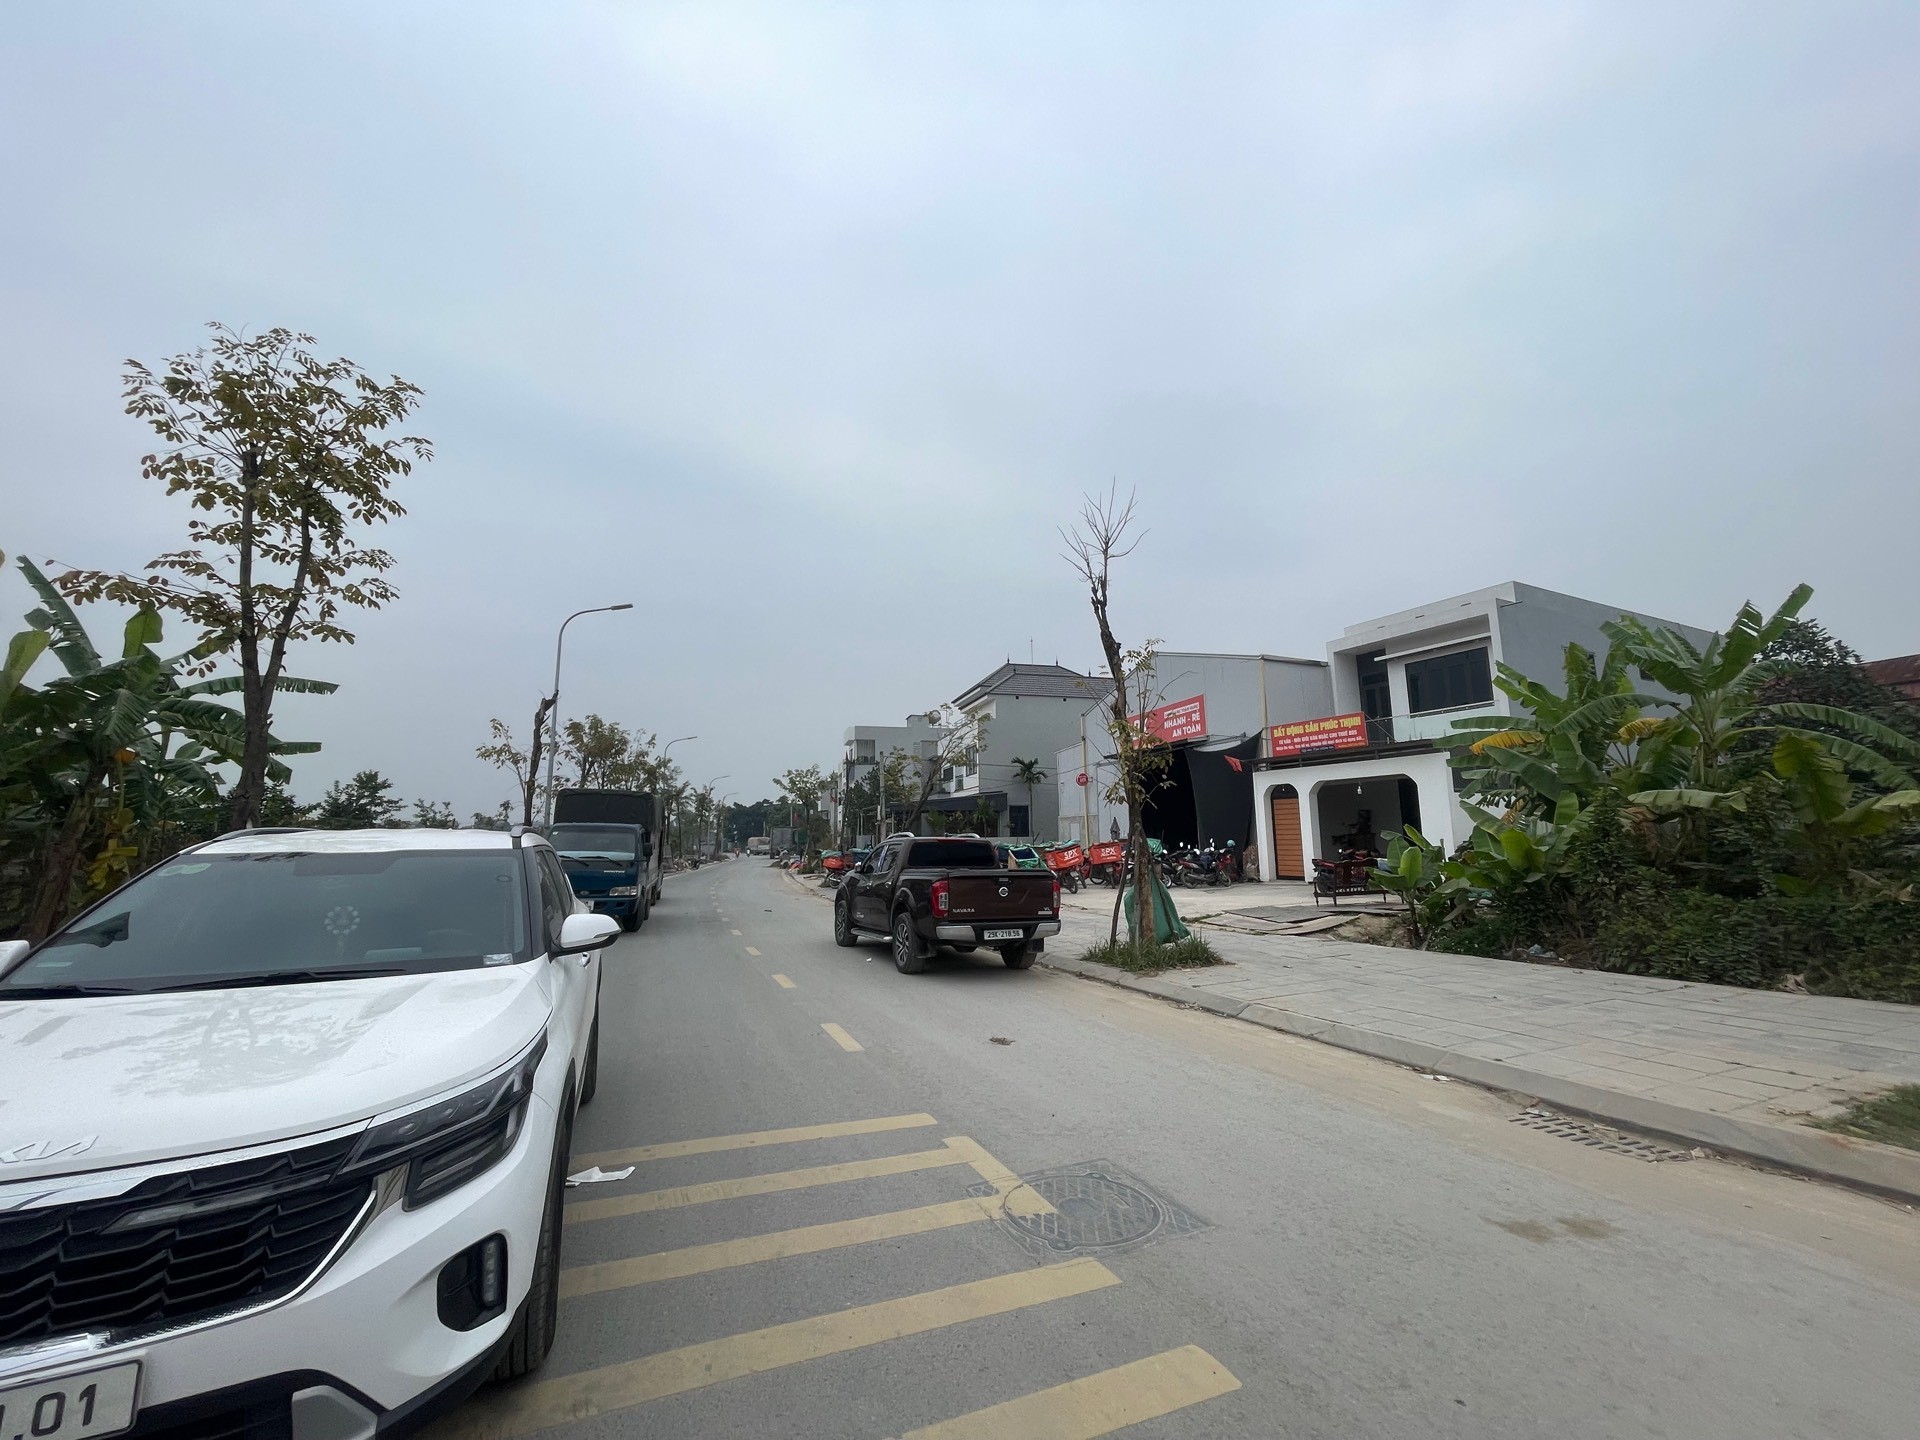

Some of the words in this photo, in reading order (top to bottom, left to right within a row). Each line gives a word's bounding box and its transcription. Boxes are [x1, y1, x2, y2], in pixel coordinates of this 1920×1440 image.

[1164, 716, 1187, 729] NHANH
[1274, 726, 1286, 737] BẤT
[1305, 722, 1319, 732] SẢN
[1320, 719, 1338, 730] PHÚC
[1340, 716, 1361, 728] THỊNH
[1173, 728, 1182, 738] AN
[1183, 723, 1200, 734] TOÀN
[1064, 848, 1078, 859] SPX
[1101, 847, 1116, 856] SPX
